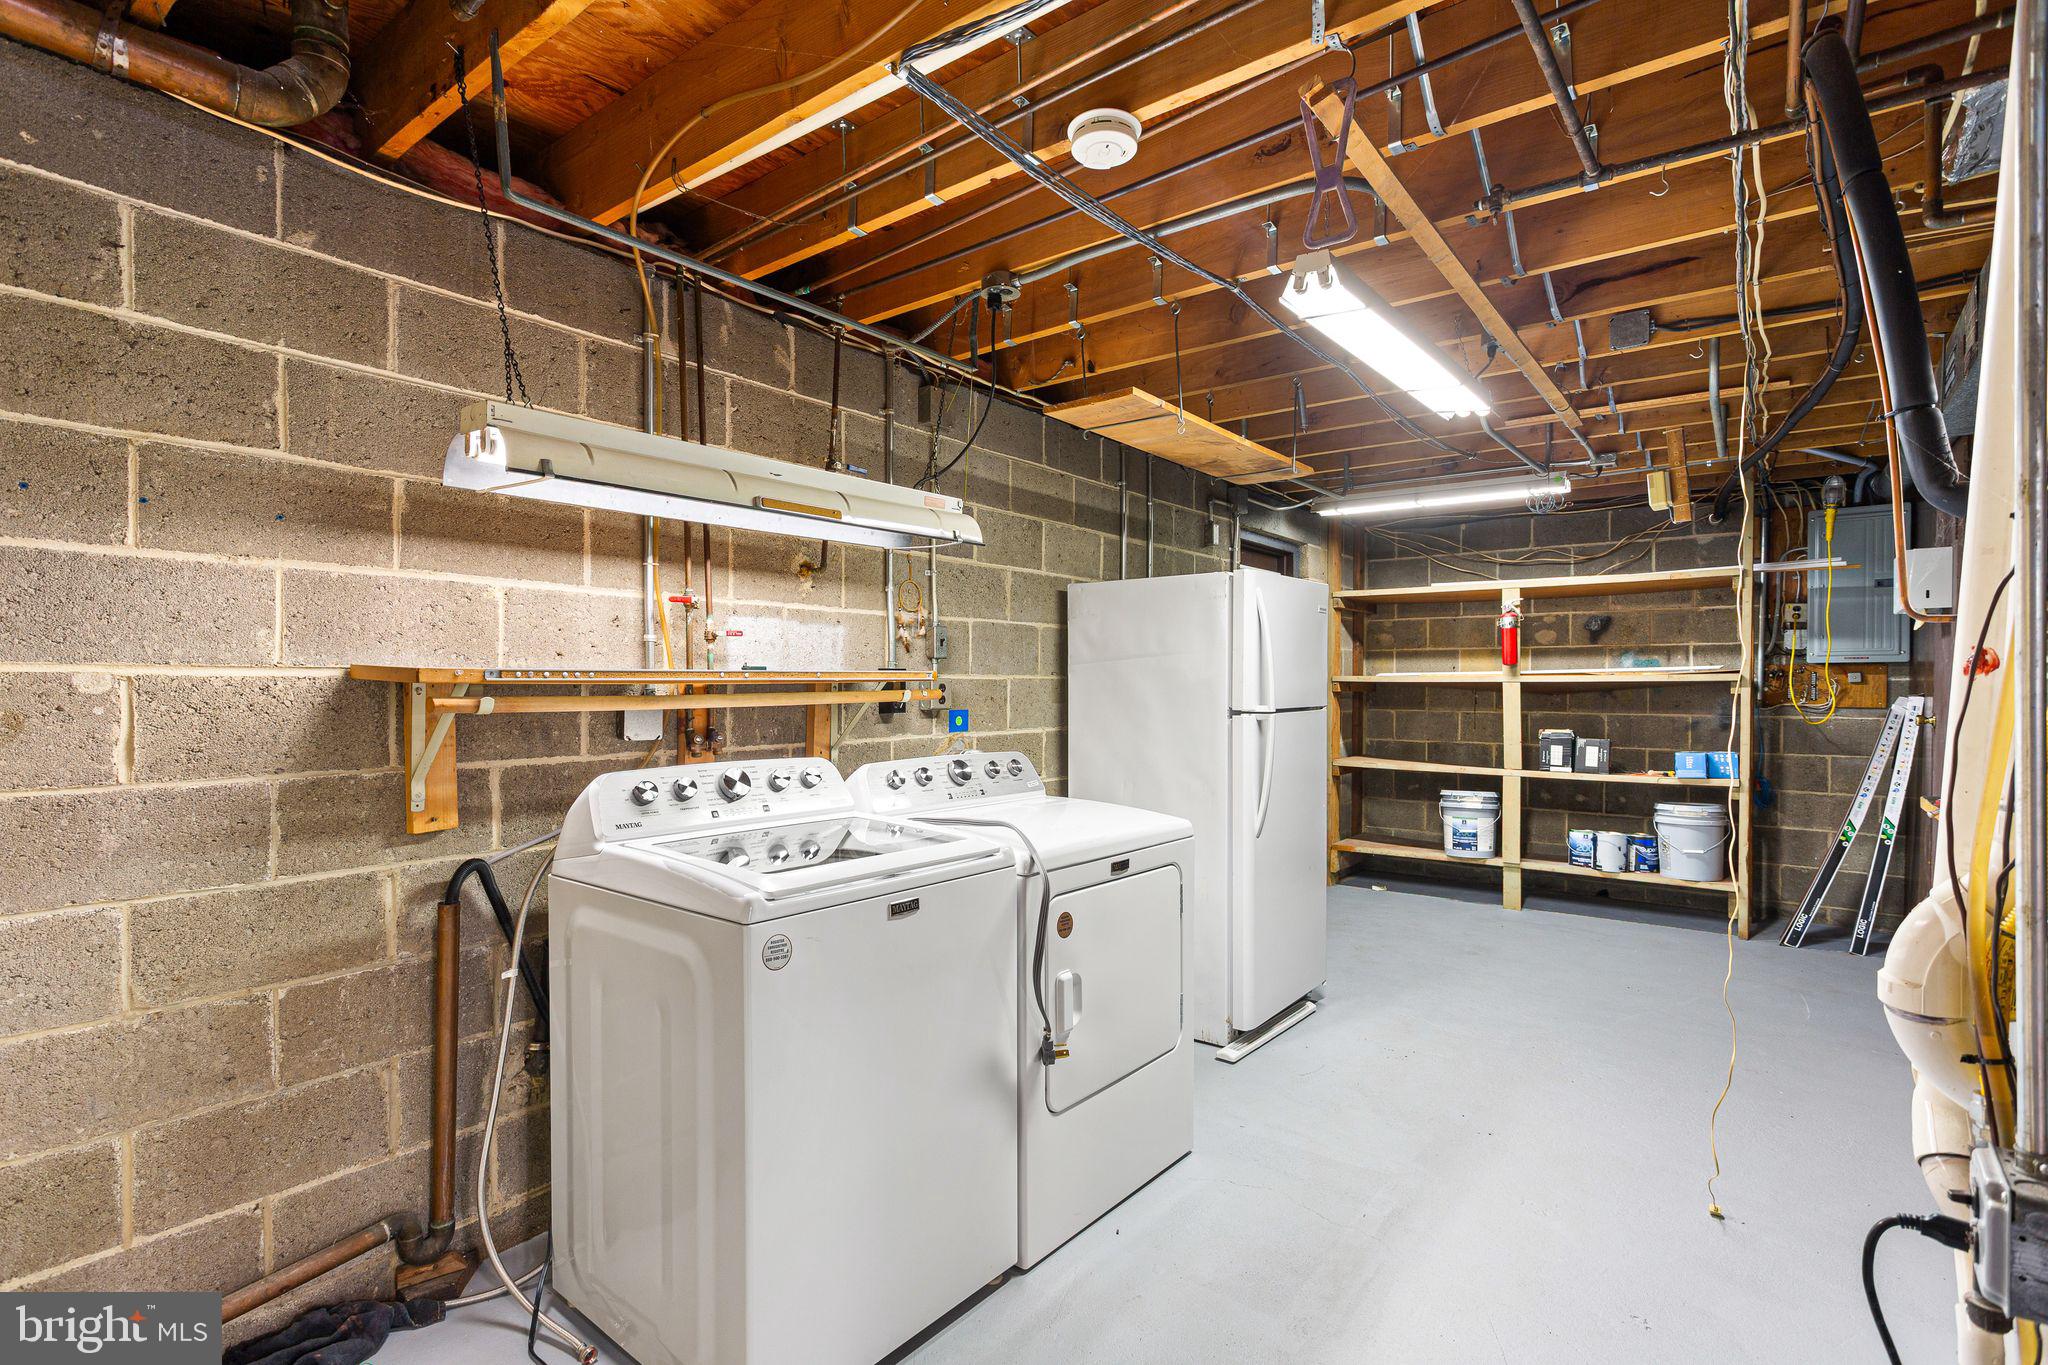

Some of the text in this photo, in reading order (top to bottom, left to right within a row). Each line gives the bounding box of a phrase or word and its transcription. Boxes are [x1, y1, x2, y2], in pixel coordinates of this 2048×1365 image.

[615, 821, 643, 830] MAYTAG
[892, 900, 918, 914] MAYTAG
[1794, 913, 1808, 932] LOGIC
[1856, 918, 1868, 939] LOGIC
